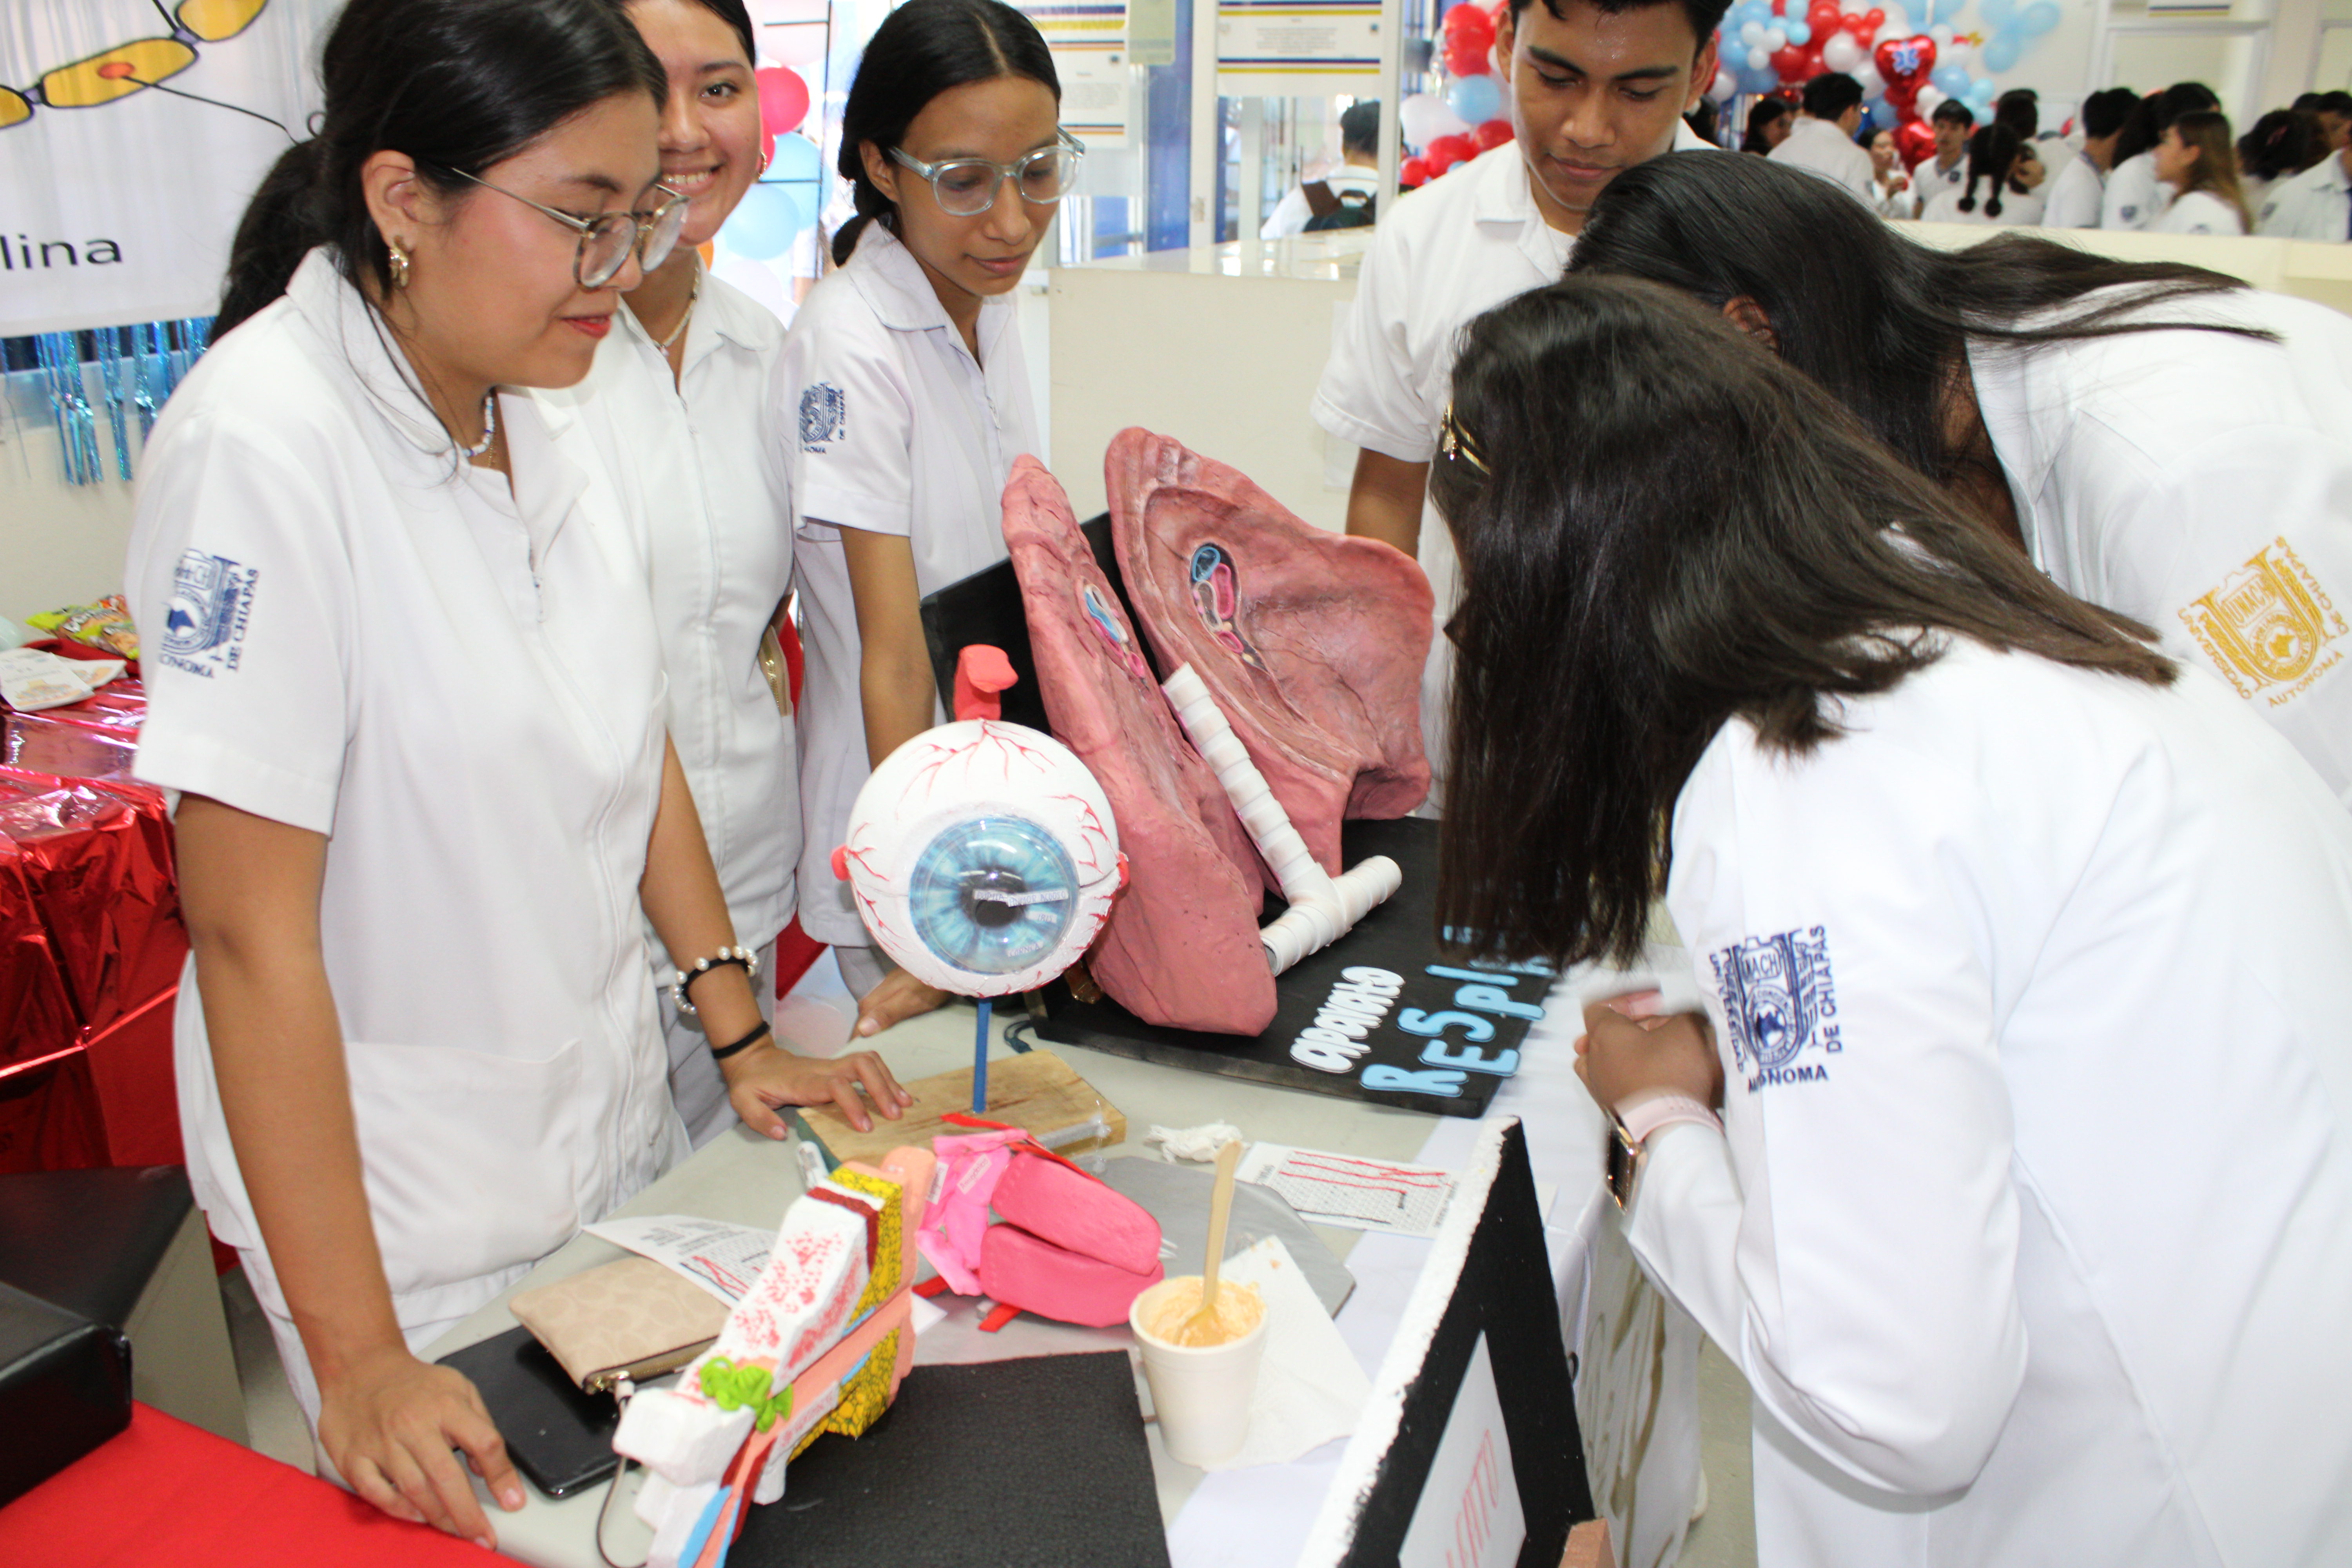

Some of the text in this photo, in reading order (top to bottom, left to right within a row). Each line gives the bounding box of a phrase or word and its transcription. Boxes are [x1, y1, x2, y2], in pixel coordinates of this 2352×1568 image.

[0, 233, 122, 270] lina
[2267, 651, 2344, 708] AUTONOMA
[1038, 913, 1053, 922] IRIS
[1810, 925, 1843, 1054] DE CHIAPAS
